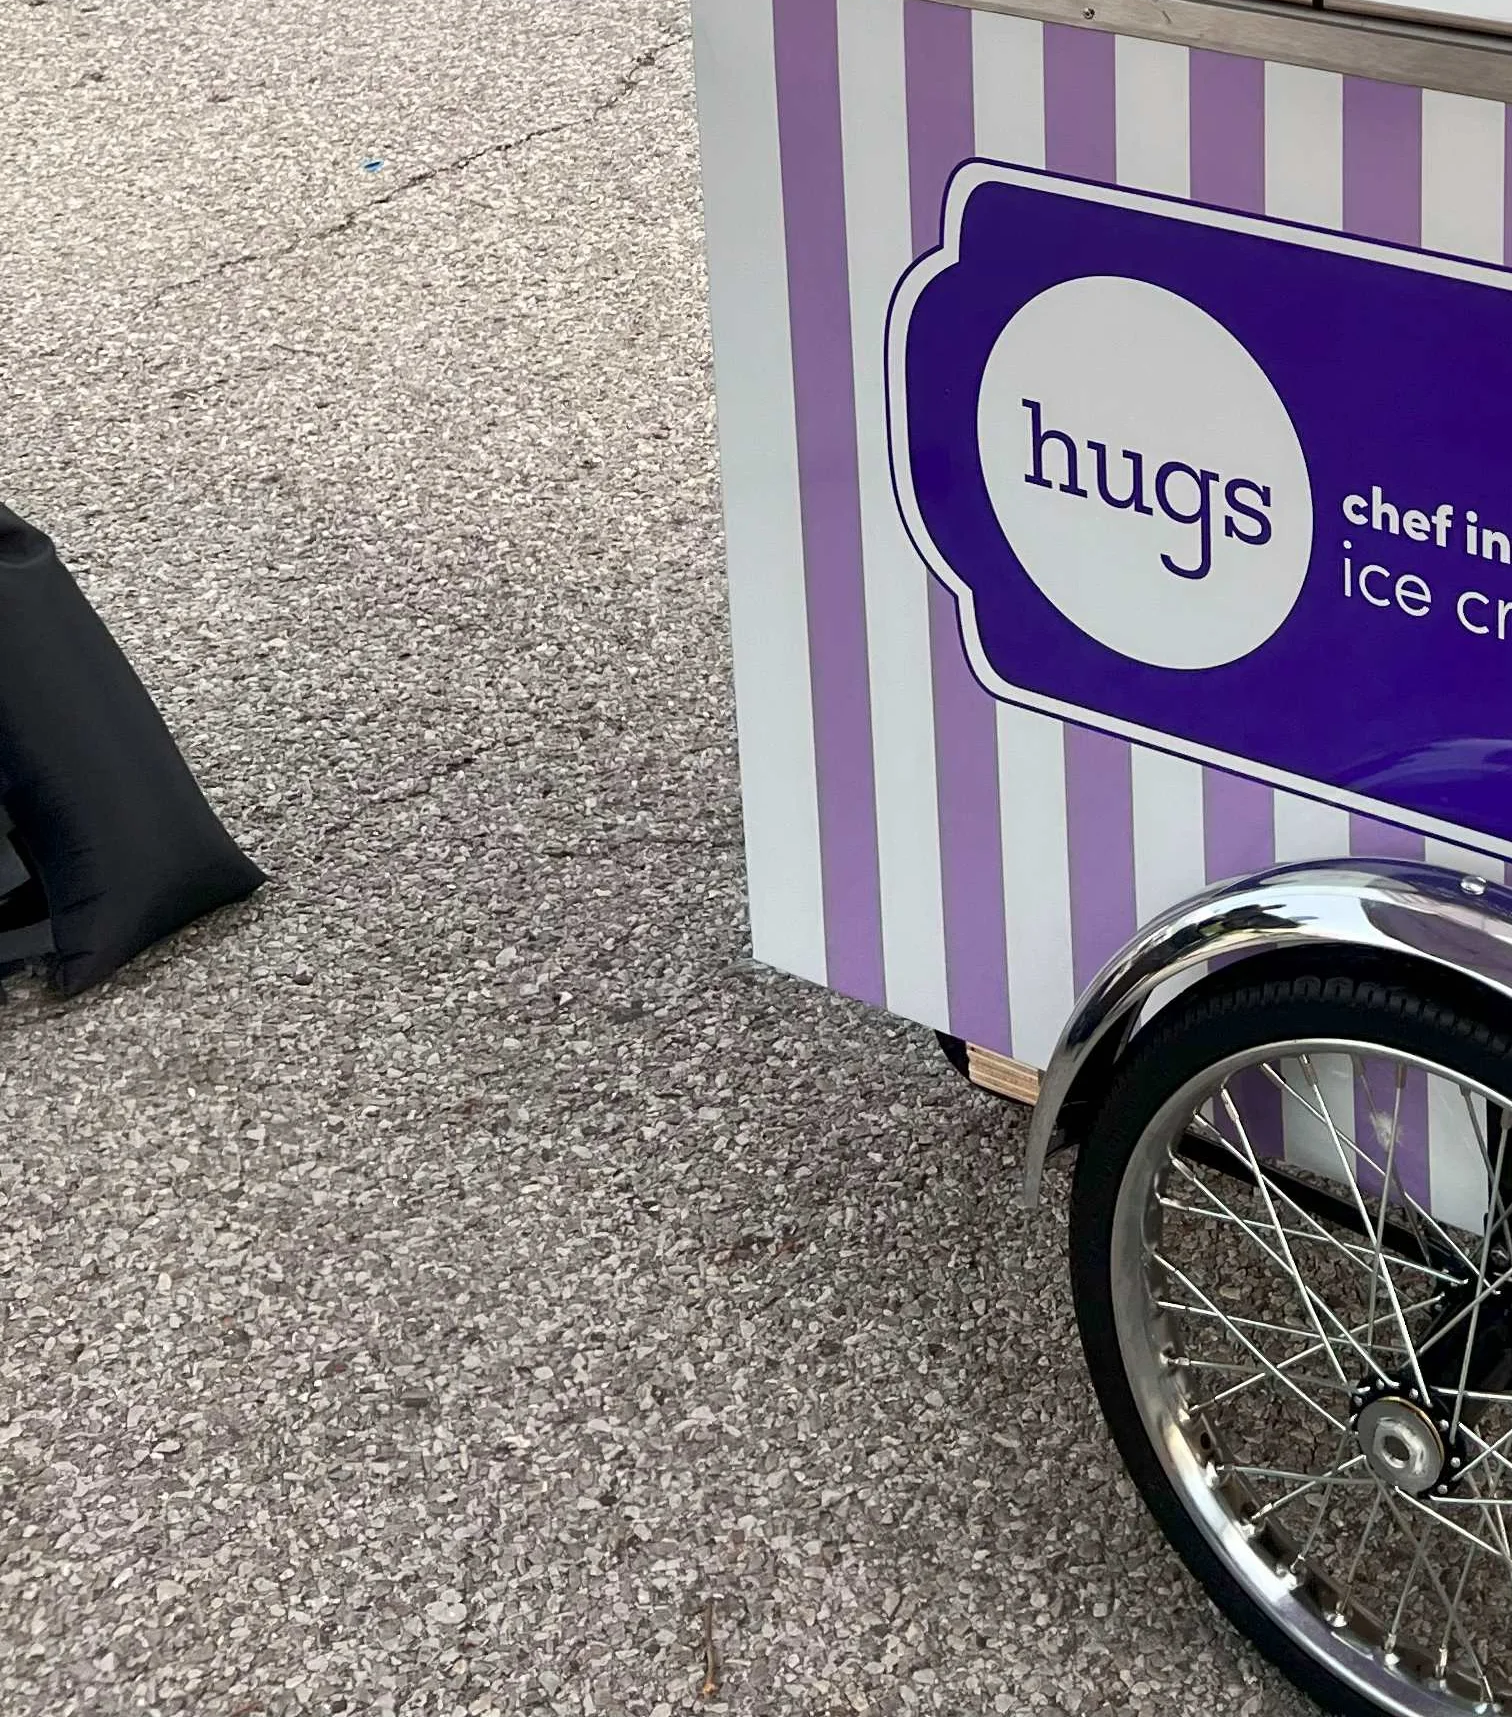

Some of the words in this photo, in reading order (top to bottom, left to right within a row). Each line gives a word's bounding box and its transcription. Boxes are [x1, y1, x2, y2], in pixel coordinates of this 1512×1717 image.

[1022, 397, 1272, 580] hugs
[1342, 485, 1454, 548] chef
[1343, 539, 1432, 617] ice
